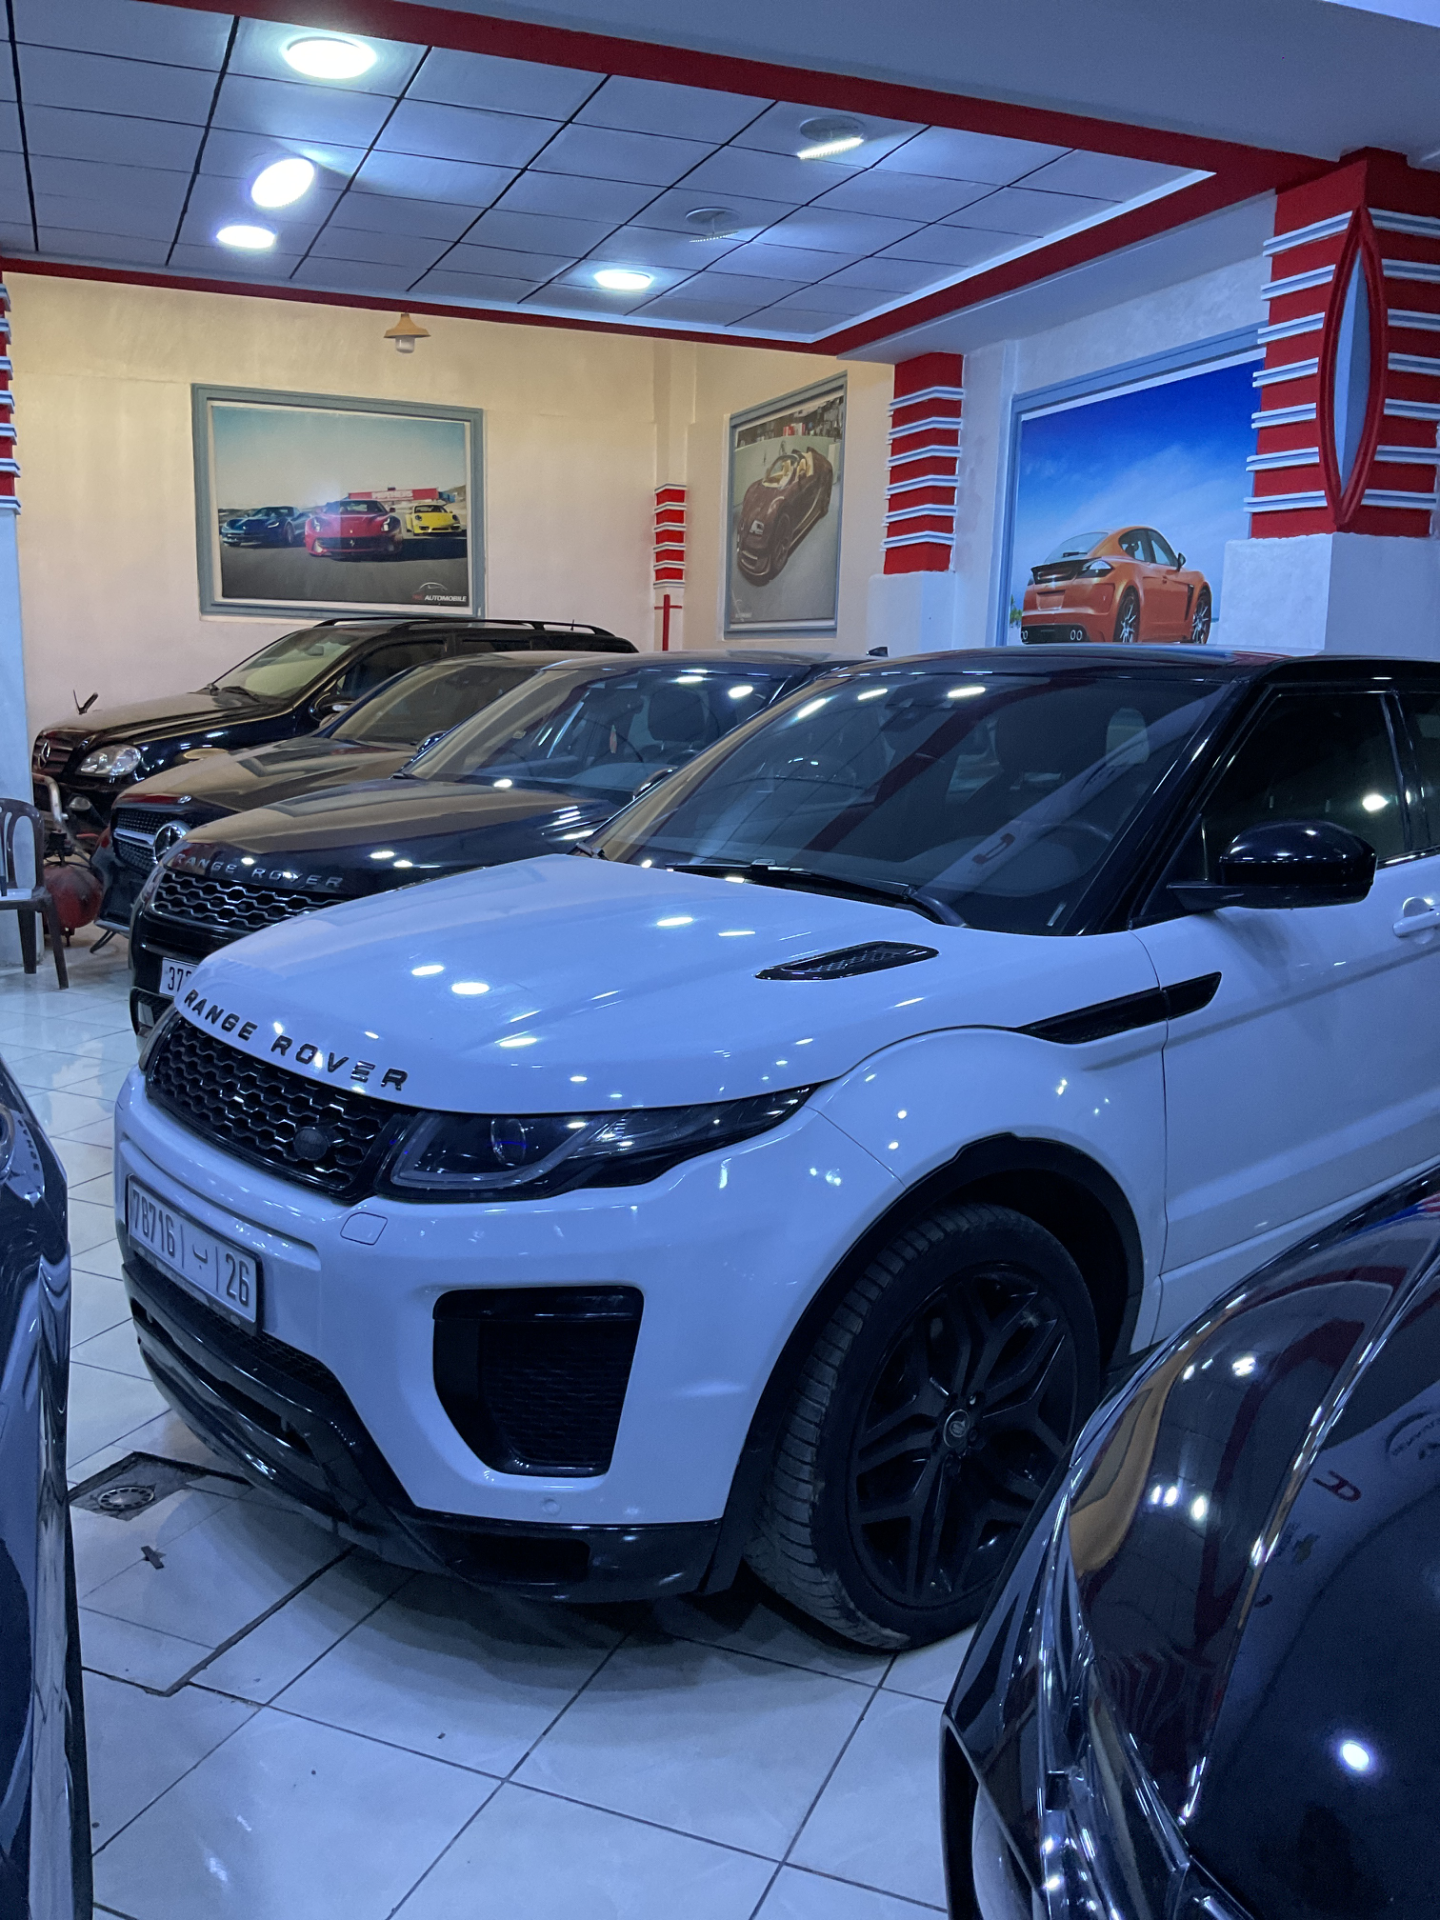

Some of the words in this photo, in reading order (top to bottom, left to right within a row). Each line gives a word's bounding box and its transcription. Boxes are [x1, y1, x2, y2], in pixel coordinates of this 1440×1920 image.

[176, 853, 237, 874] RANGE
[251, 867, 343, 887] ROVER
[168, 966, 192, 992] 37
[184, 989, 258, 1041] RANGE
[270, 1035, 408, 1091] ROVER
[132, 1189, 176, 1258] 78716
[192, 1244, 208, 1270] ب
[225, 1253, 249, 1307] 26
